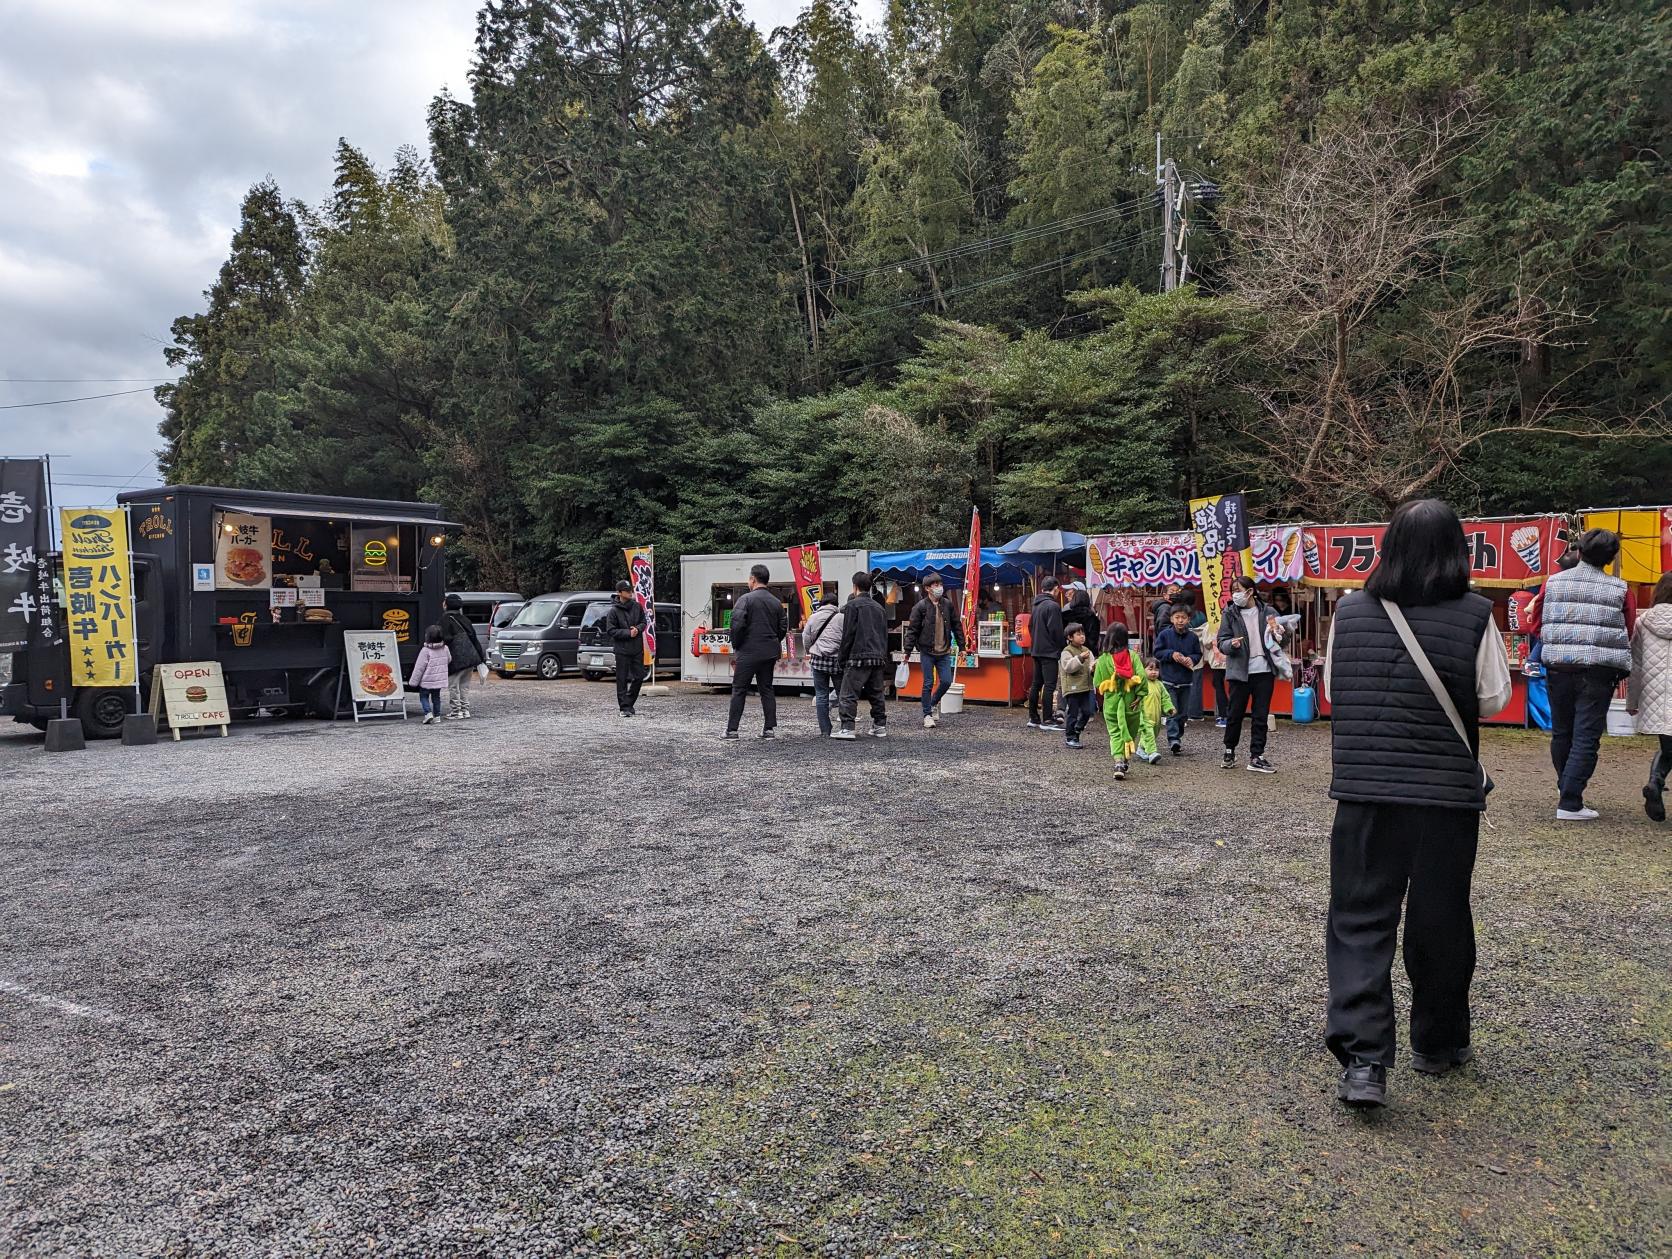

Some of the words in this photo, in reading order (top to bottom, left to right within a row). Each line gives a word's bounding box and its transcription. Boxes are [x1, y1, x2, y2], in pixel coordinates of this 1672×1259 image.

[139, 515, 173, 537] TROLL
[231, 534, 257, 546] バーガー
[358, 642, 385, 651] 壱岐牛
[362, 651, 385, 660] バーガー
[174, 669, 210, 679] OPEN
[202, 711, 225, 719] CAFE
